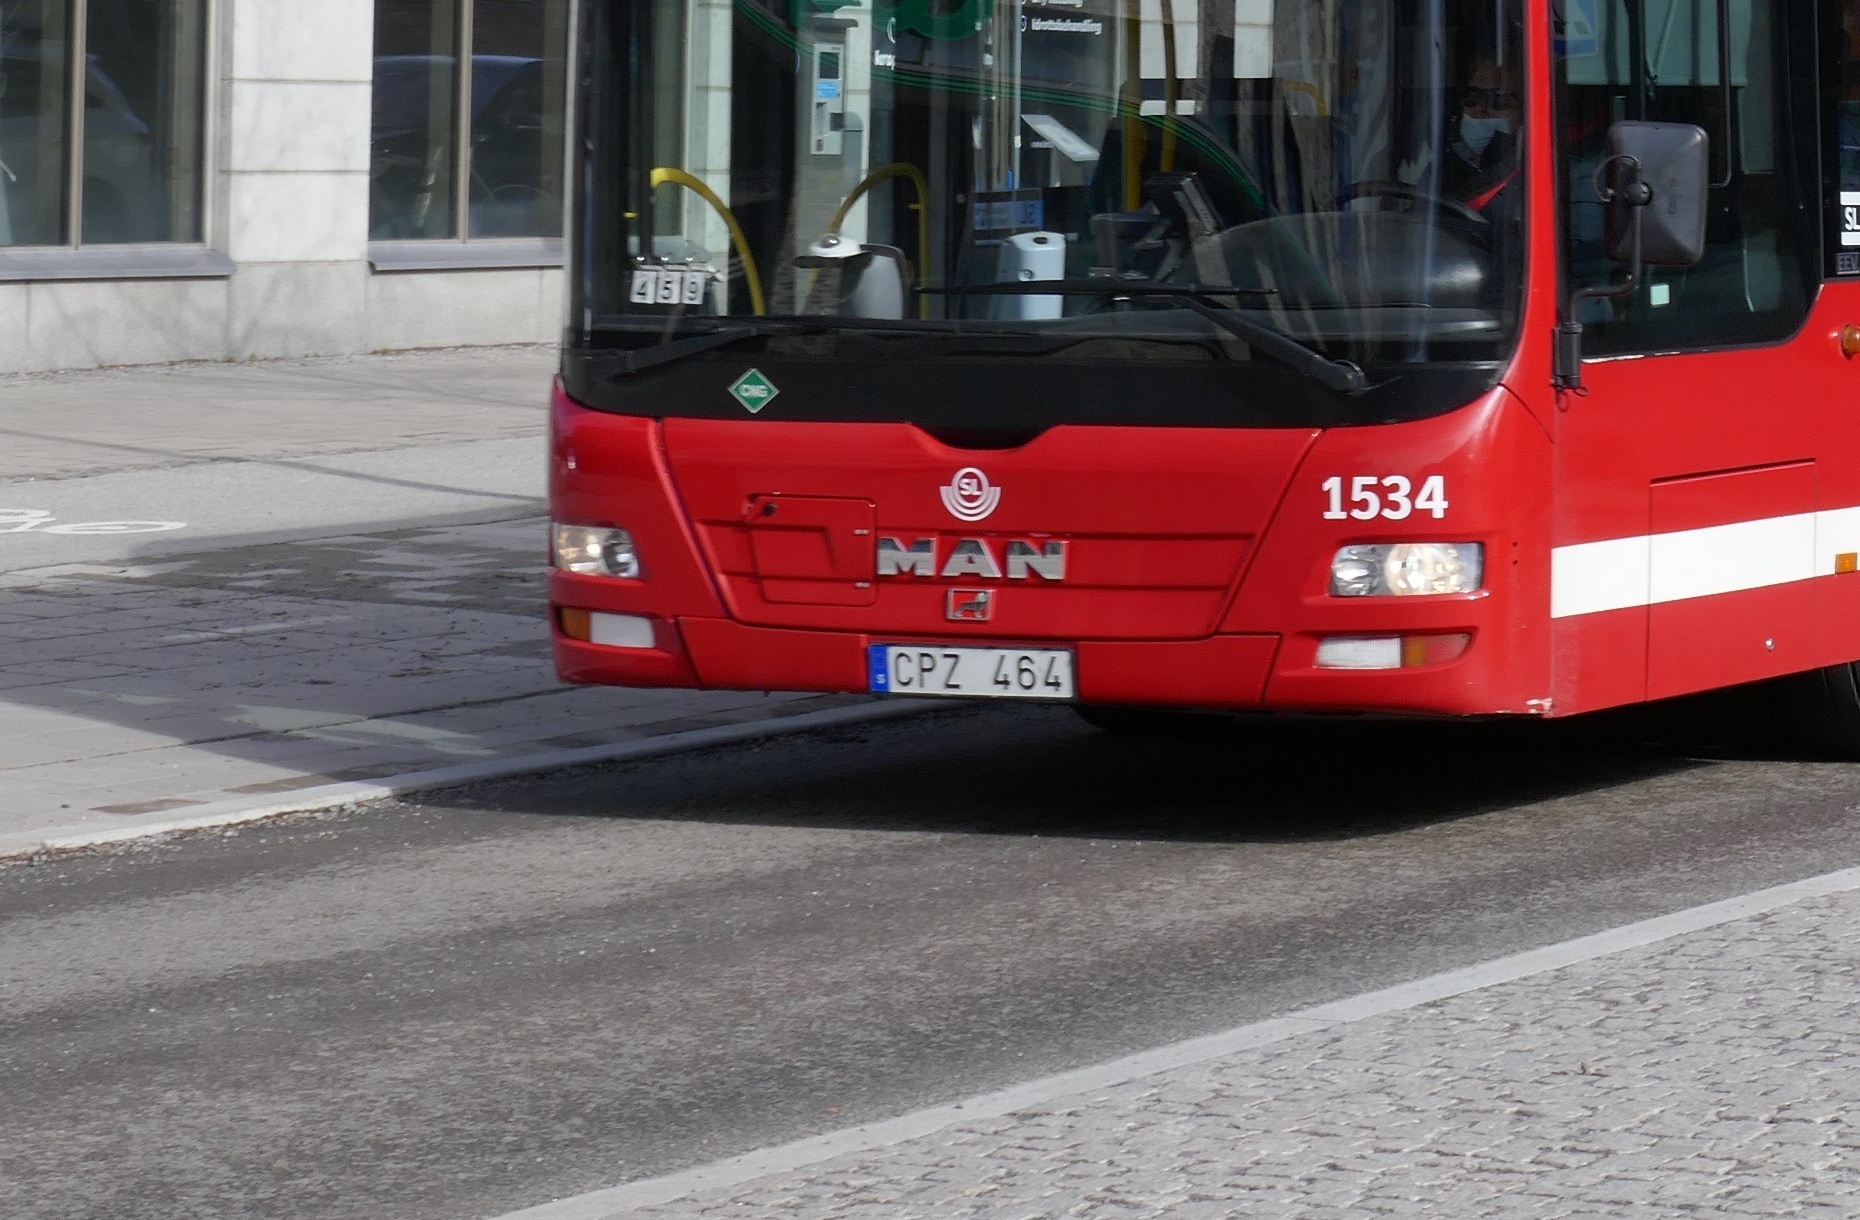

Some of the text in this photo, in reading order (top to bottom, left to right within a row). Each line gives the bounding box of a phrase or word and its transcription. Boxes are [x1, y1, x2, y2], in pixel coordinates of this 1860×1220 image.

[1844, 207, 1860, 230] SL
[958, 478, 982, 495] SL
[1322, 475, 1449, 520] 1534
[877, 536, 1069, 580] MAN
[894, 652, 1062, 692] CPZ 464
